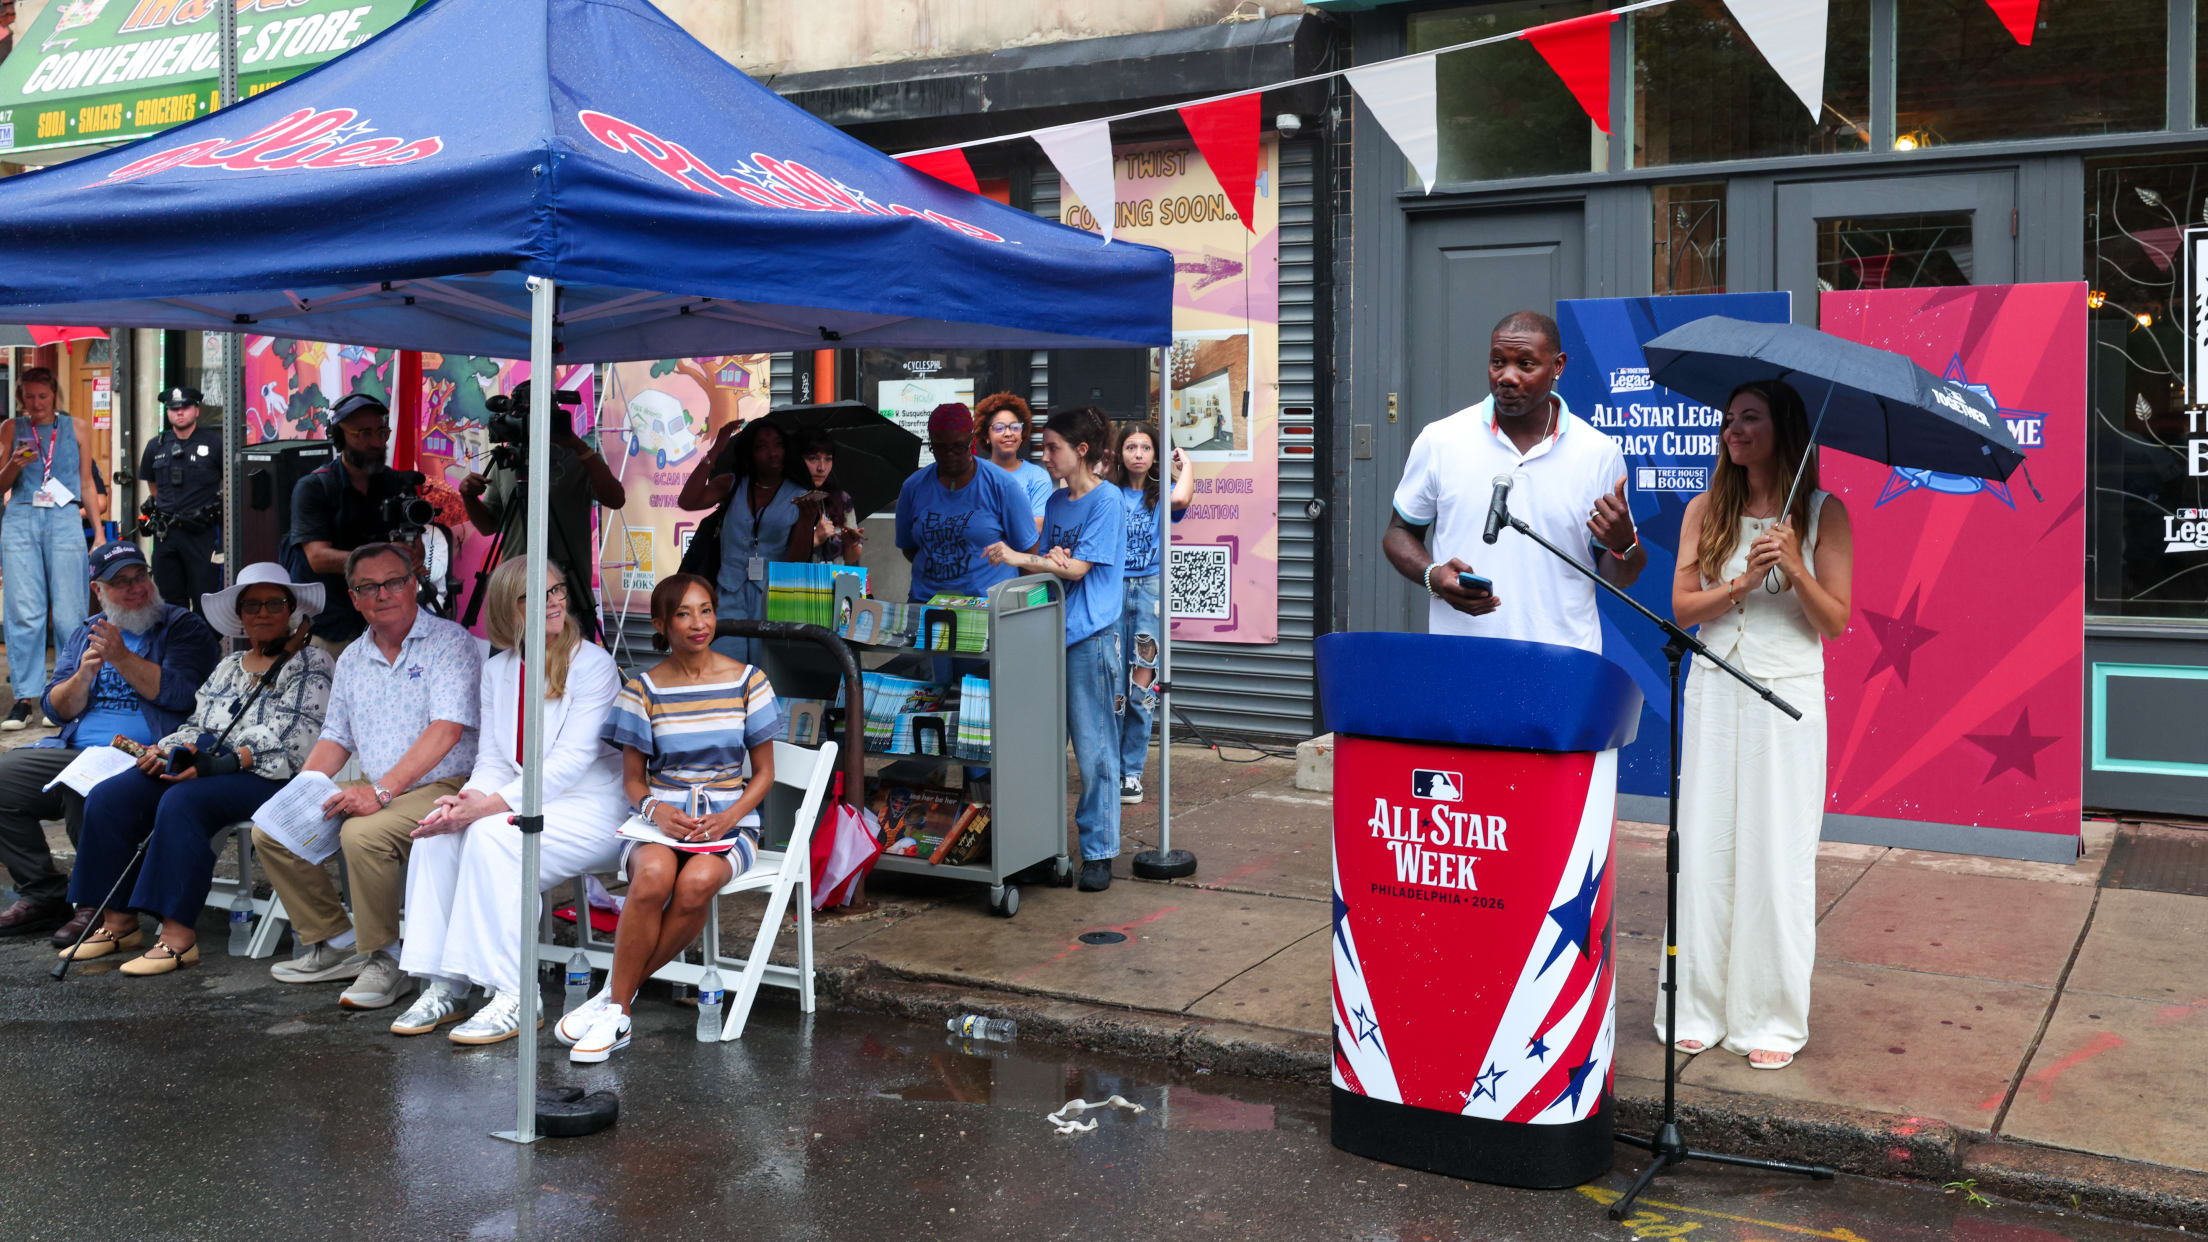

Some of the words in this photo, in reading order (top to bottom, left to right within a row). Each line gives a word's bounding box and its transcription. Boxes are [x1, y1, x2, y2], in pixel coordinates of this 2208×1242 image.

[242, 6, 372, 64] STORE
[38, 110, 66, 138] SODA
[78, 103, 123, 134] SNACKS
[134, 93, 197, 127] GROCERIES
[1126, 148, 1189, 180] TWIST
[1066, 199, 1153, 230] COING
[1931, 387, 1991, 429] TOGETHER
[1612, 434, 1659, 456] RACY
[653, 472, 681, 486] SCAN
[1216, 478, 1253, 494] MORE
[1657, 469, 1677, 477] TREE
[1678, 469, 1704, 477] HOUSE
[1657, 477, 1704, 489] BOOKS
[1429, 803, 1509, 852] STAR
[1386, 840, 1479, 891] WEEK
[1370, 883, 1461, 905] PHILADELPHIA
[1472, 895, 1505, 910] 2026
